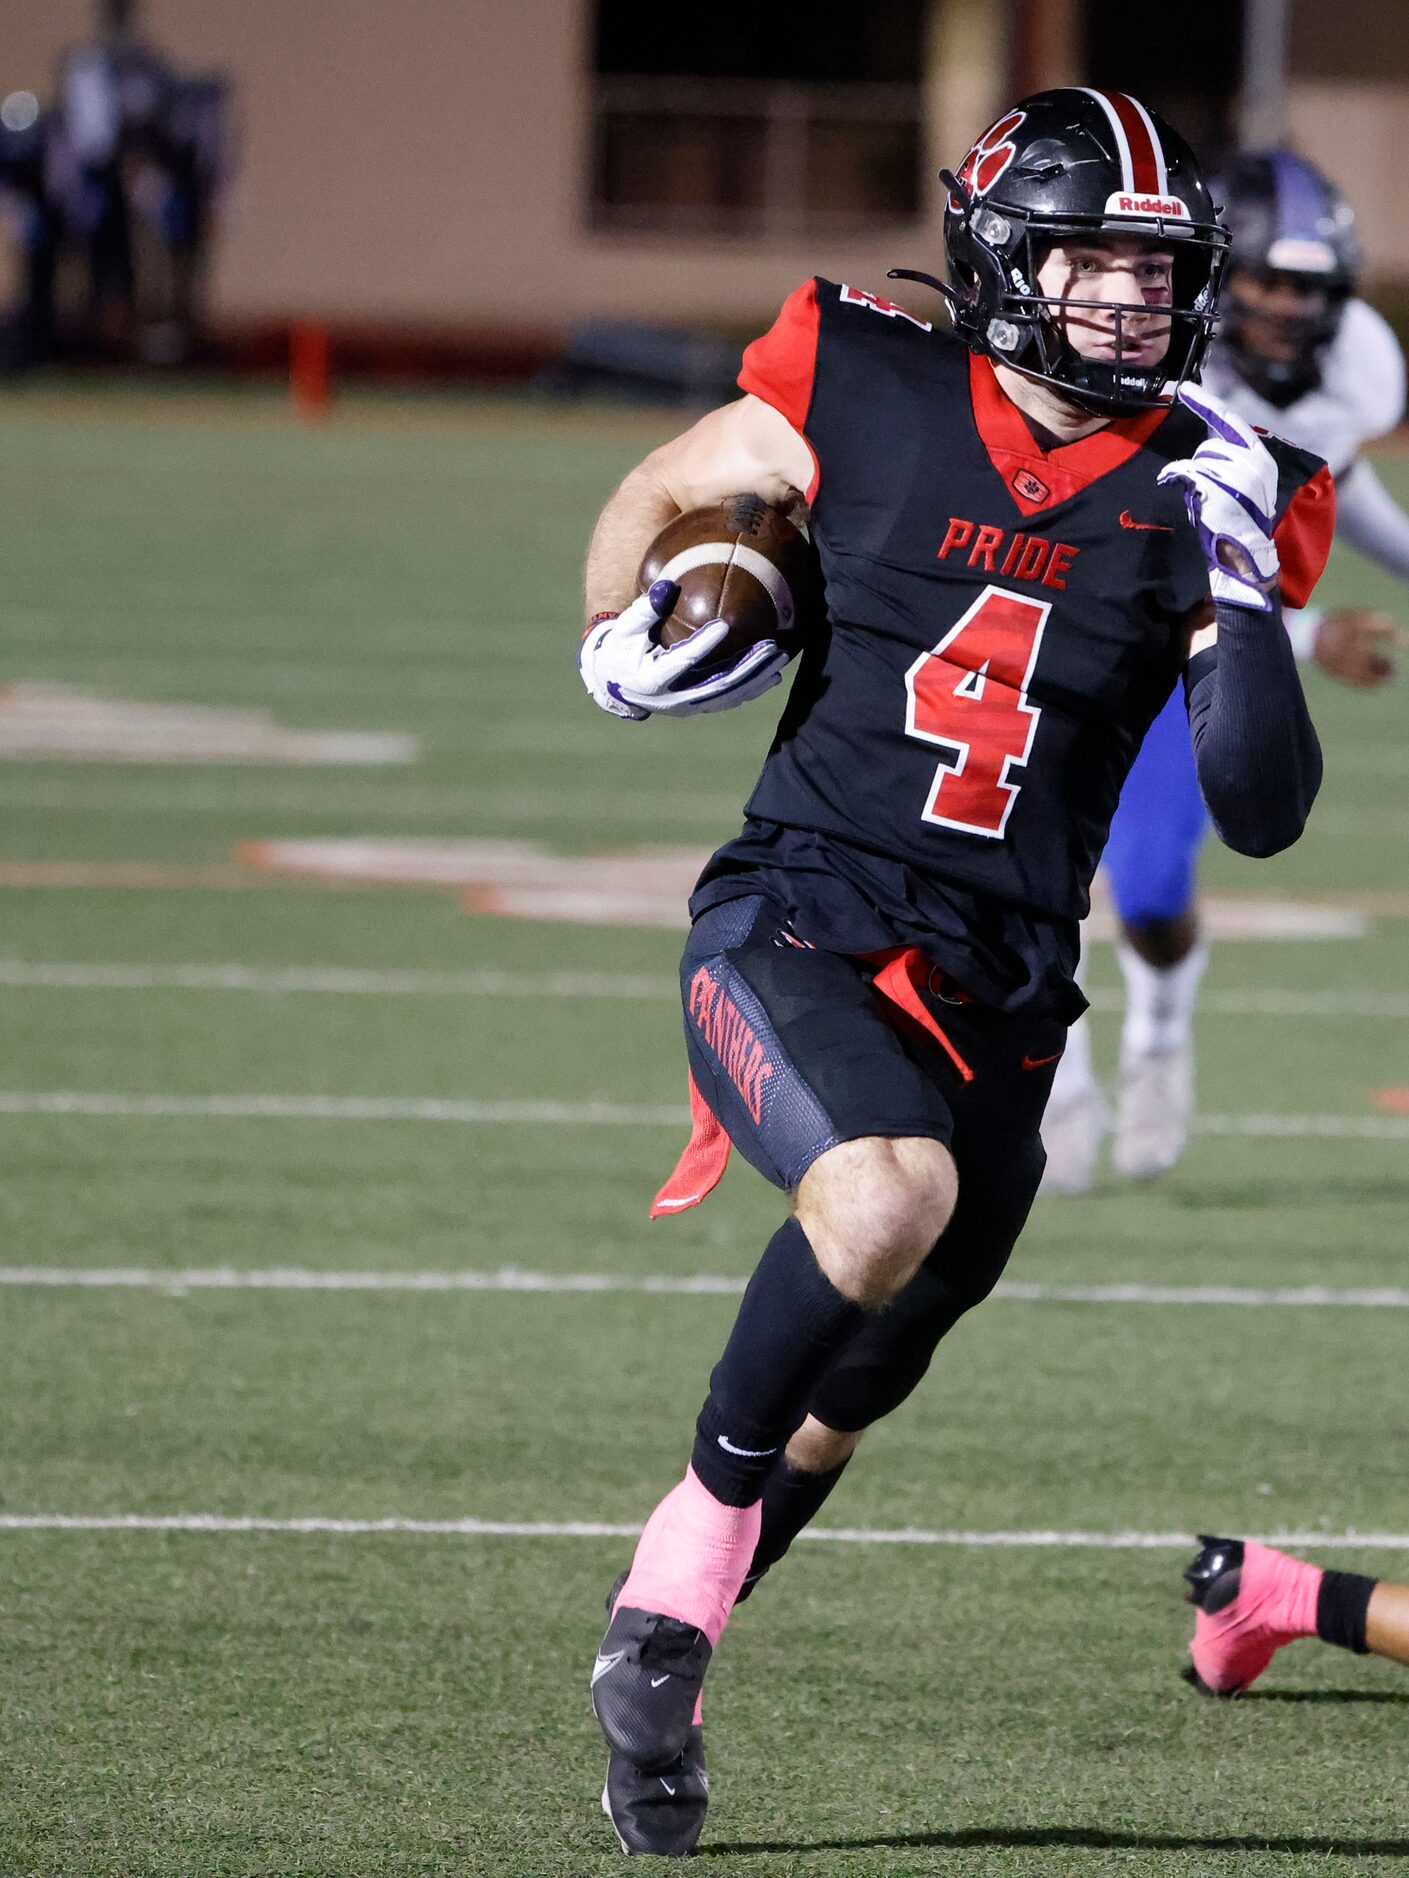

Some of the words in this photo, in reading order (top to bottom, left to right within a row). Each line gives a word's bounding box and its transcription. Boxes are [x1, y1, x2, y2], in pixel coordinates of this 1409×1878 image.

[1119, 197, 1182, 216] Riddell
[938, 518, 1080, 590] PRIDE
[905, 584, 1053, 840] 4
